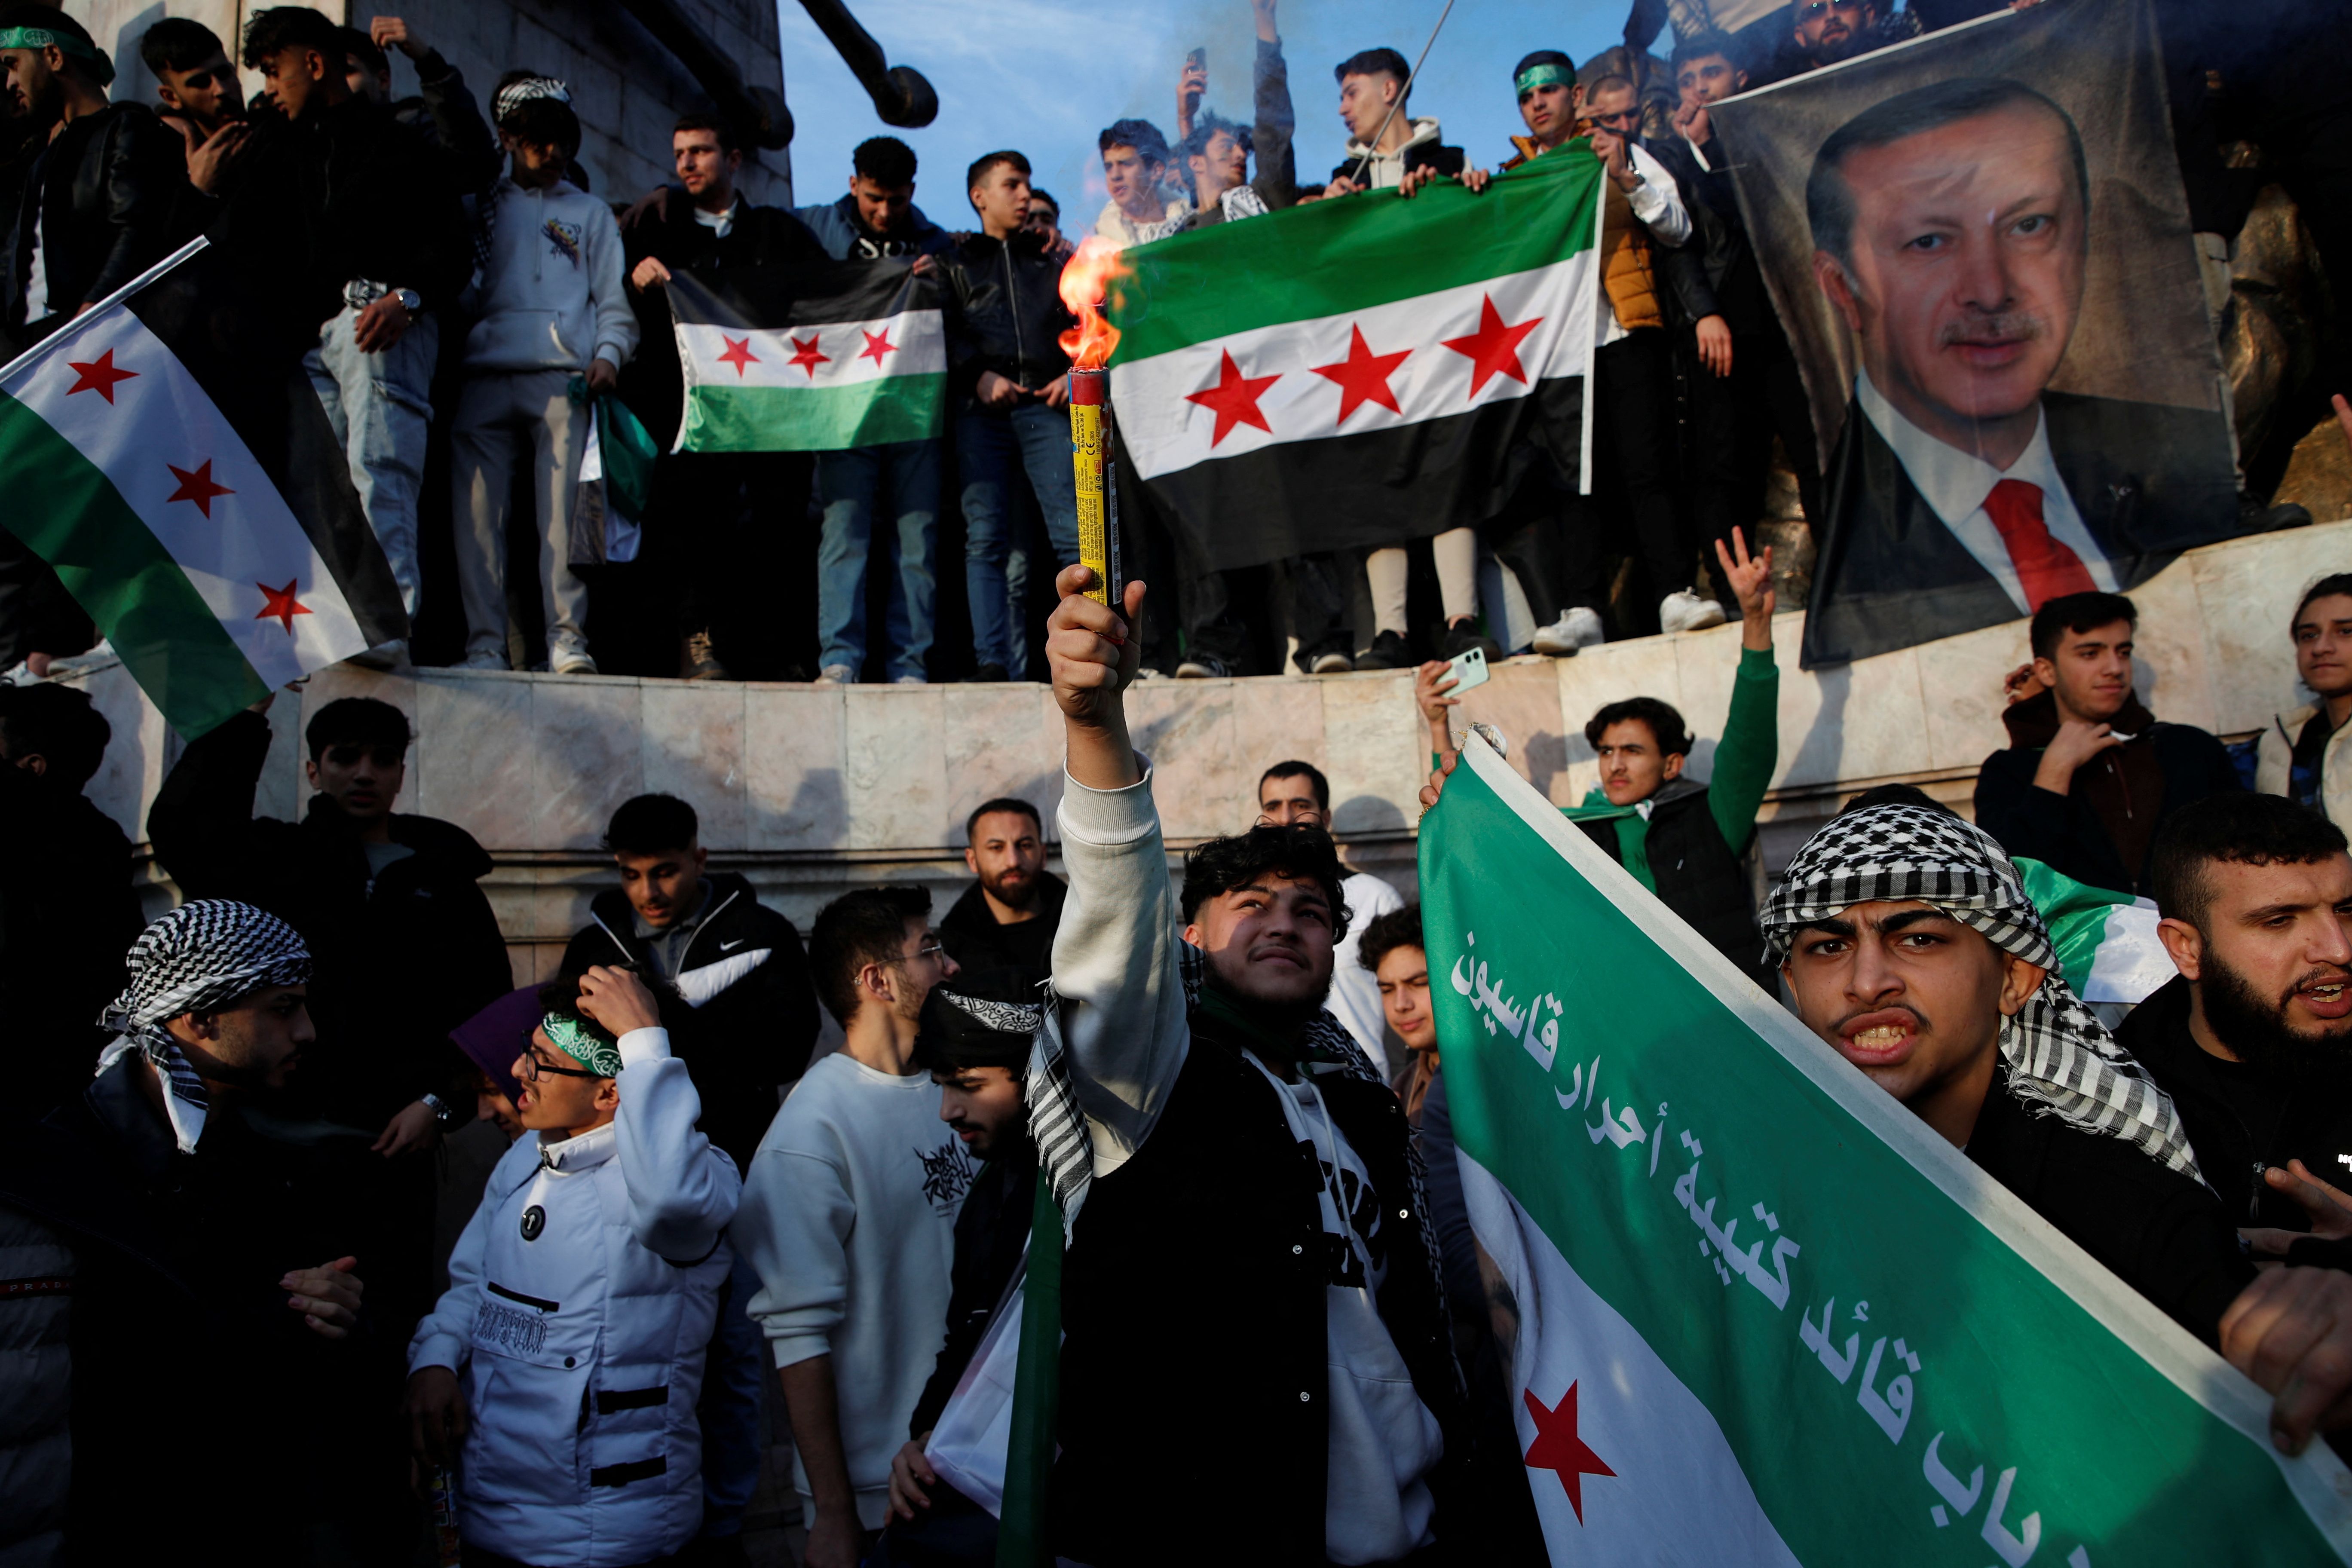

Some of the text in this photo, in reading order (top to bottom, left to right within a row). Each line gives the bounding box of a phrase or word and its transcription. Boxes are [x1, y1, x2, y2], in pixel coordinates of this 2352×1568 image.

[1451, 931, 1564, 1073] قاسيون
[1554, 1054, 1668, 1178] أحرار
[9, 1281, 72, 1292] PRADA
[1673, 1129, 1801, 1311] كتيبة
[1799, 1295, 1922, 1446] قائد
